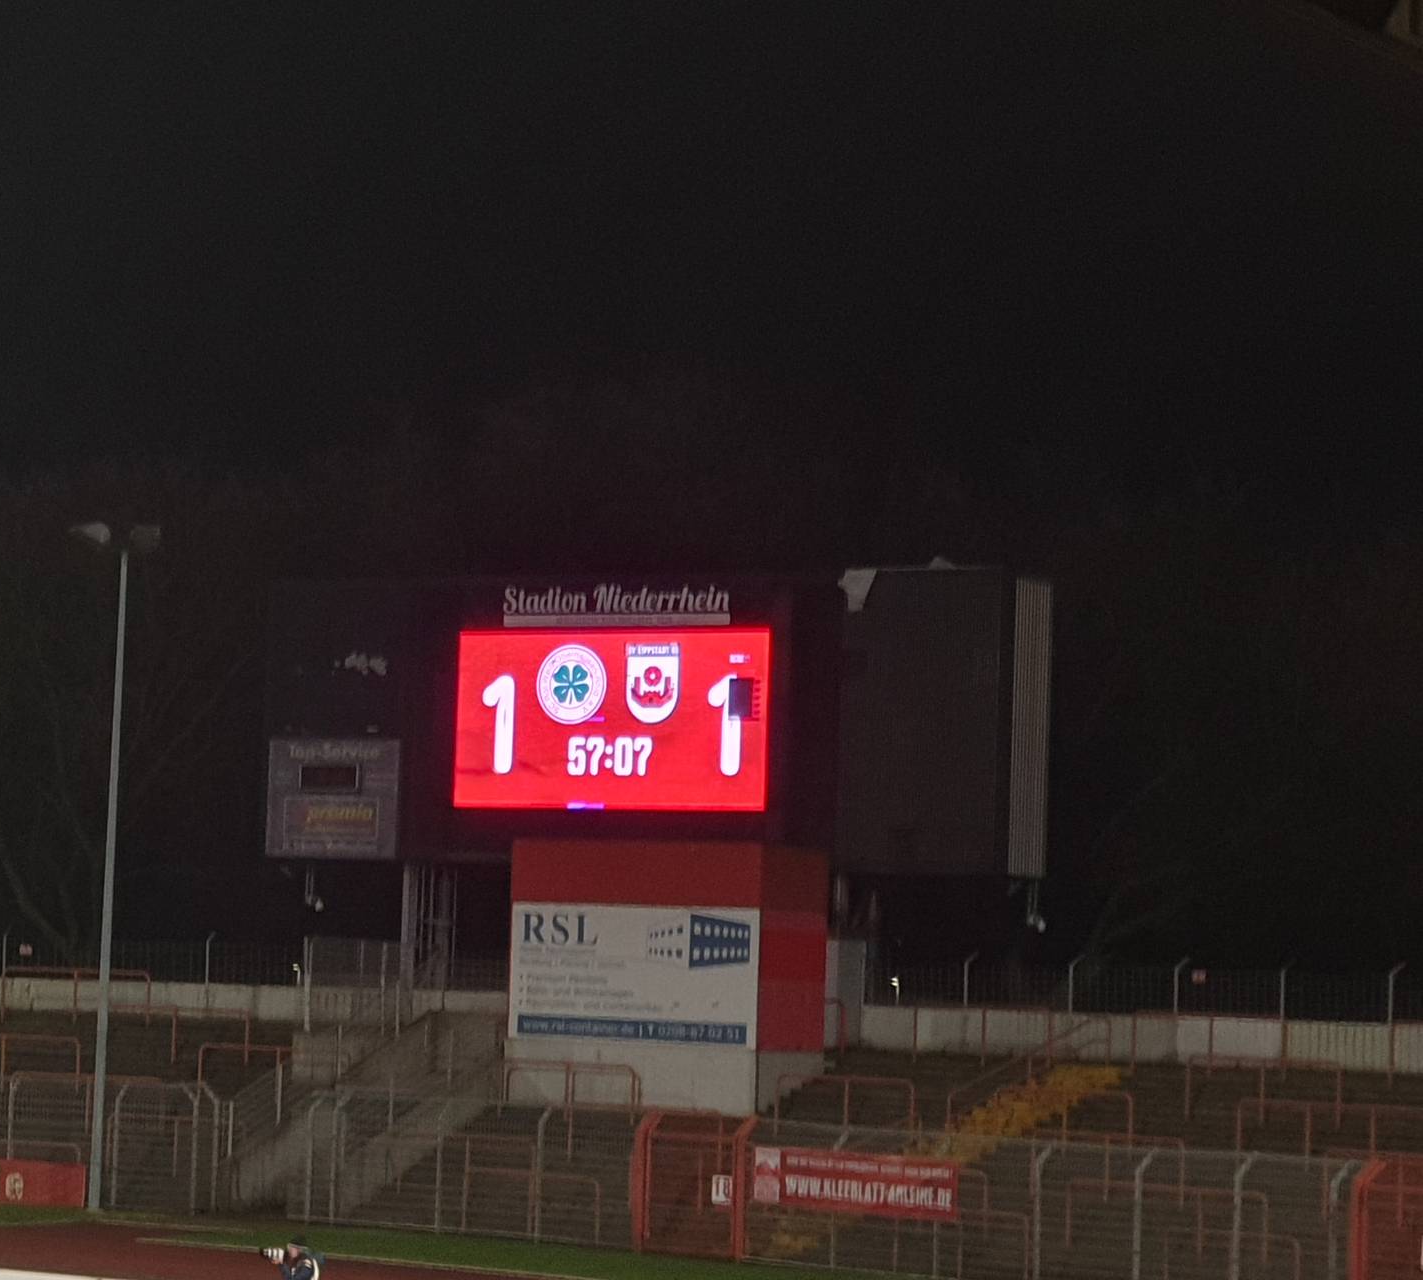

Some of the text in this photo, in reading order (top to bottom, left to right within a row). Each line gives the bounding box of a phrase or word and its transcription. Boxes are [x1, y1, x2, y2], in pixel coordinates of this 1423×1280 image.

[503, 584, 730, 614] Stadion Niederrhein
[482, 674, 515, 775] 1
[708, 674, 741, 776] 1
[567, 736, 653, 776] 57:07
[523, 912, 598, 945] RSL
